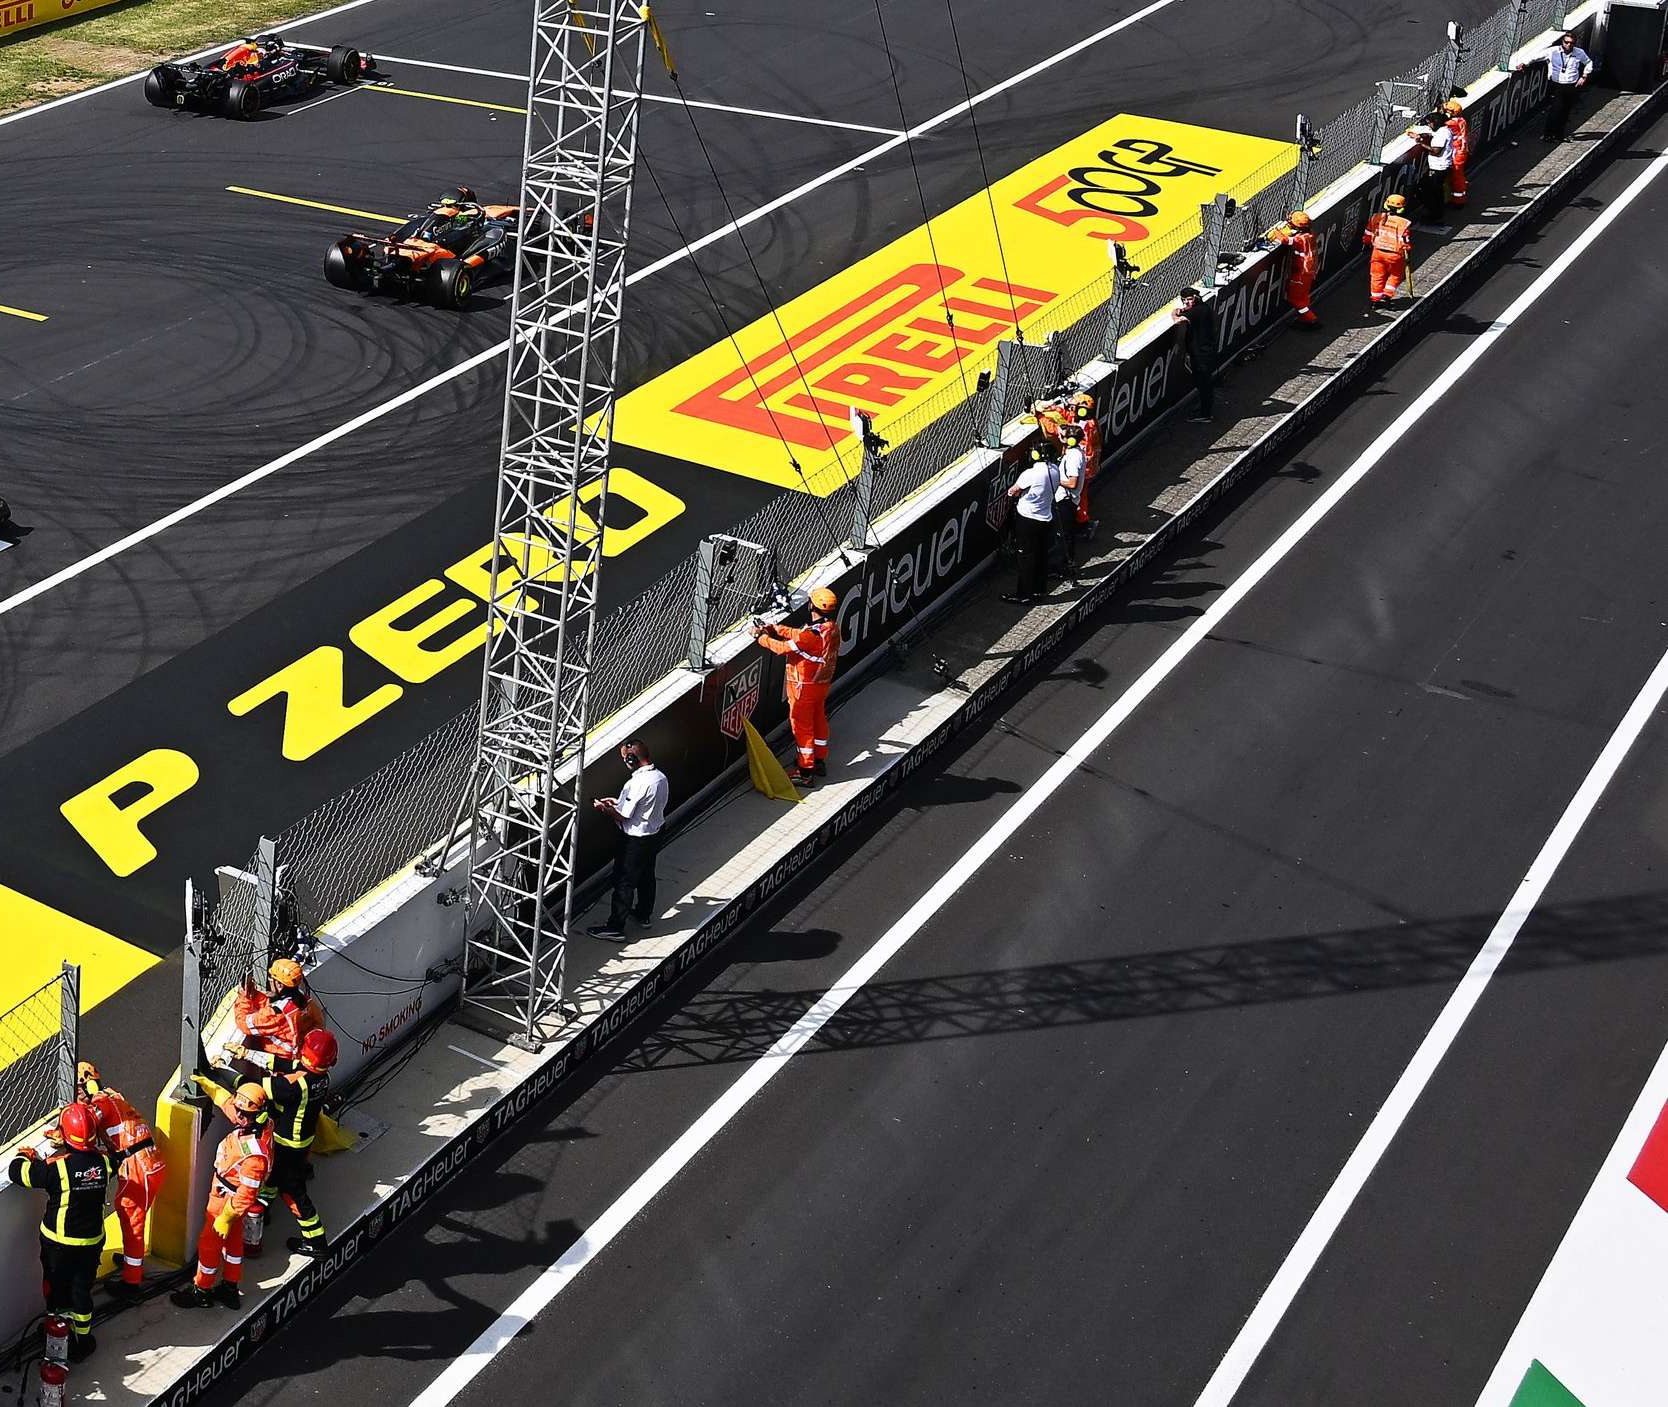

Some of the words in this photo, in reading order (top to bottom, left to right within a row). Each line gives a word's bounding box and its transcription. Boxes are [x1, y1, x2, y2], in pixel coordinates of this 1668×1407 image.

[672, 262, 1059, 452] PIRELLI
[61, 748, 200, 878] P
[228, 467, 687, 762] ZERO
[728, 668, 759, 703] TAG
[963, 670, 1012, 723] TAGHeuer
[898, 724, 953, 778] TAGHeuer
[832, 778, 889, 834] TAGHeuer
[758, 836, 820, 899] TAGHeuer
[678, 900, 742, 970] TAGHeuer
[362, 1032, 377, 1056] NO
[378, 995, 424, 1045] SMOKING
[591, 968, 662, 1053] TAGHeuer
[494, 1046, 570, 1130] TAGHeuer
[387, 1133, 473, 1224] TAGHeuer
[272, 1229, 365, 1324] TAGHeuer
